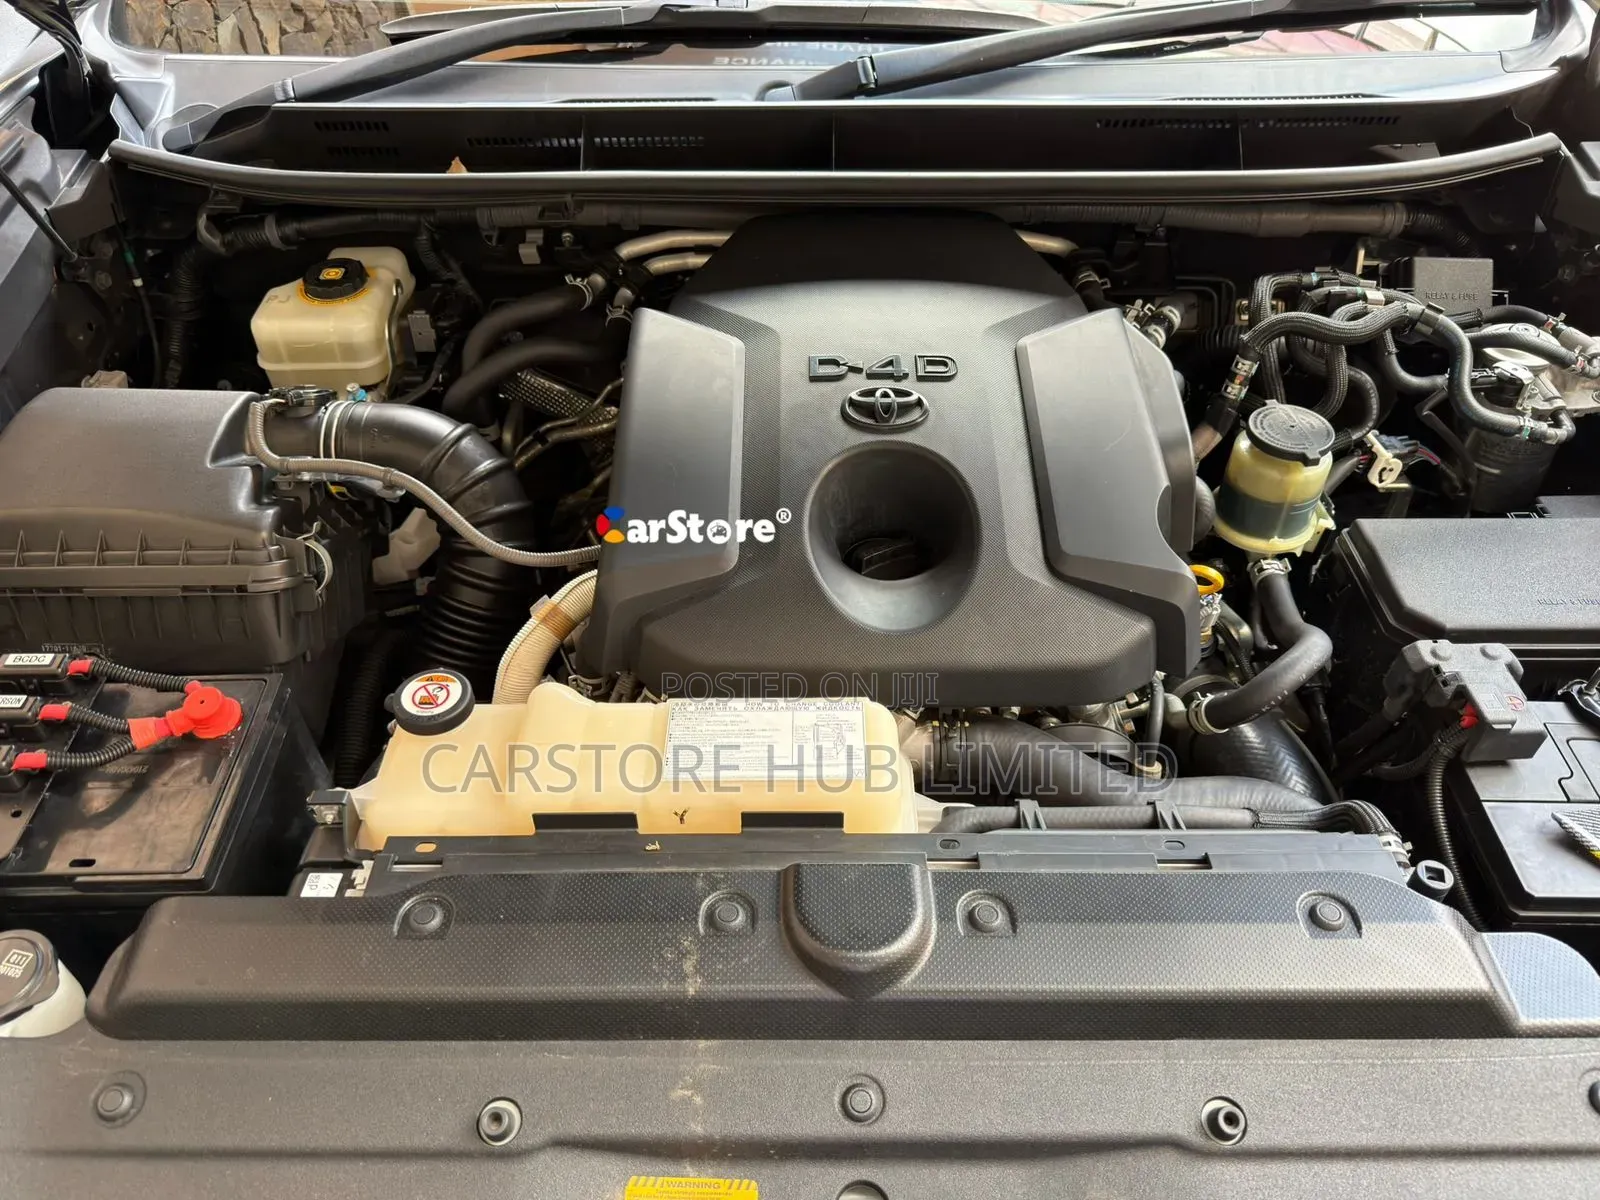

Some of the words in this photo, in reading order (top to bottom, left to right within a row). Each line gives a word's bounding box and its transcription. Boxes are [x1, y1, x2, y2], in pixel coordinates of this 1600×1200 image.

[1425, 291, 1448, 300] RELAY
[1459, 291, 1478, 300] FUSE
[809, 354, 958, 382] D-4D
[12, 655, 46, 663] BCDC
[665, 1180, 721, 1189] WARNING
